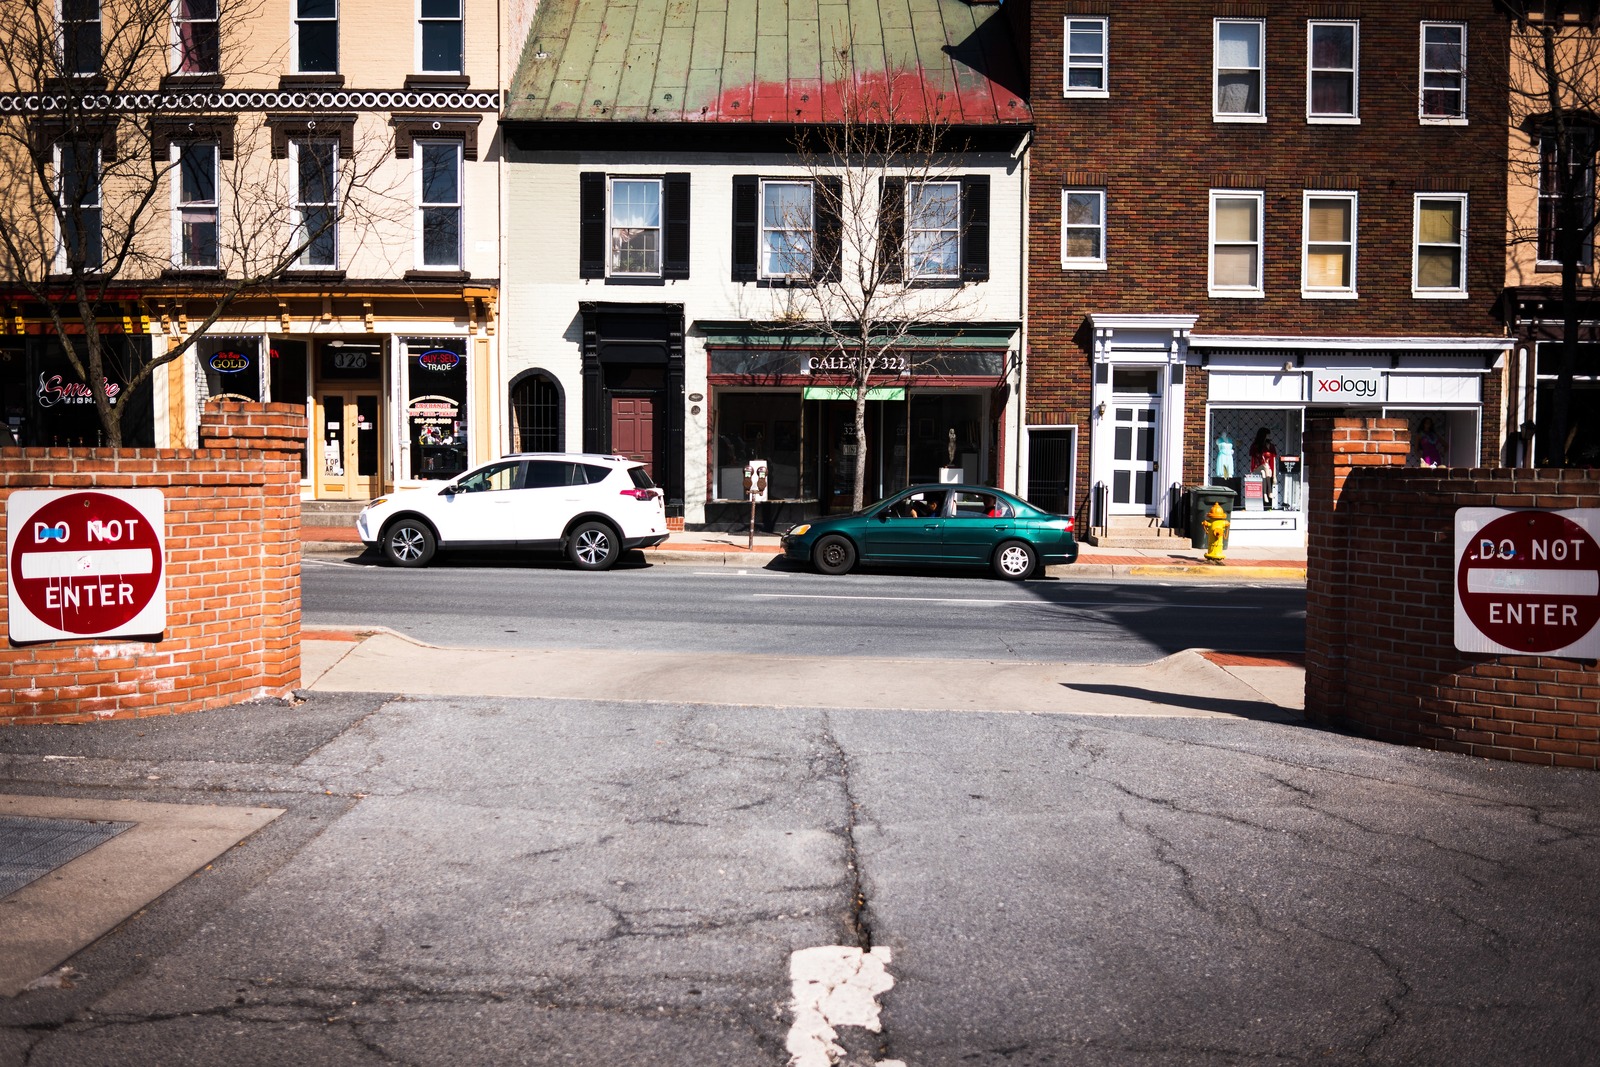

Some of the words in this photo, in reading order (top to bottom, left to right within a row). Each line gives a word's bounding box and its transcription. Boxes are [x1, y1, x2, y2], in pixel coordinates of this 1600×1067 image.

[212, 360, 247, 369] GOLD
[427, 363, 452, 371] TRADE
[880, 357, 905, 370] 322
[1318, 375, 1377, 397] xology
[34, 521, 70, 544] DO
[87, 519, 139, 542] NOT
[1480, 539, 1516, 560] DO
[1532, 539, 1585, 561] NOT
[46, 583, 134, 609] ENTER
[1489, 602, 1578, 626] ENTER
